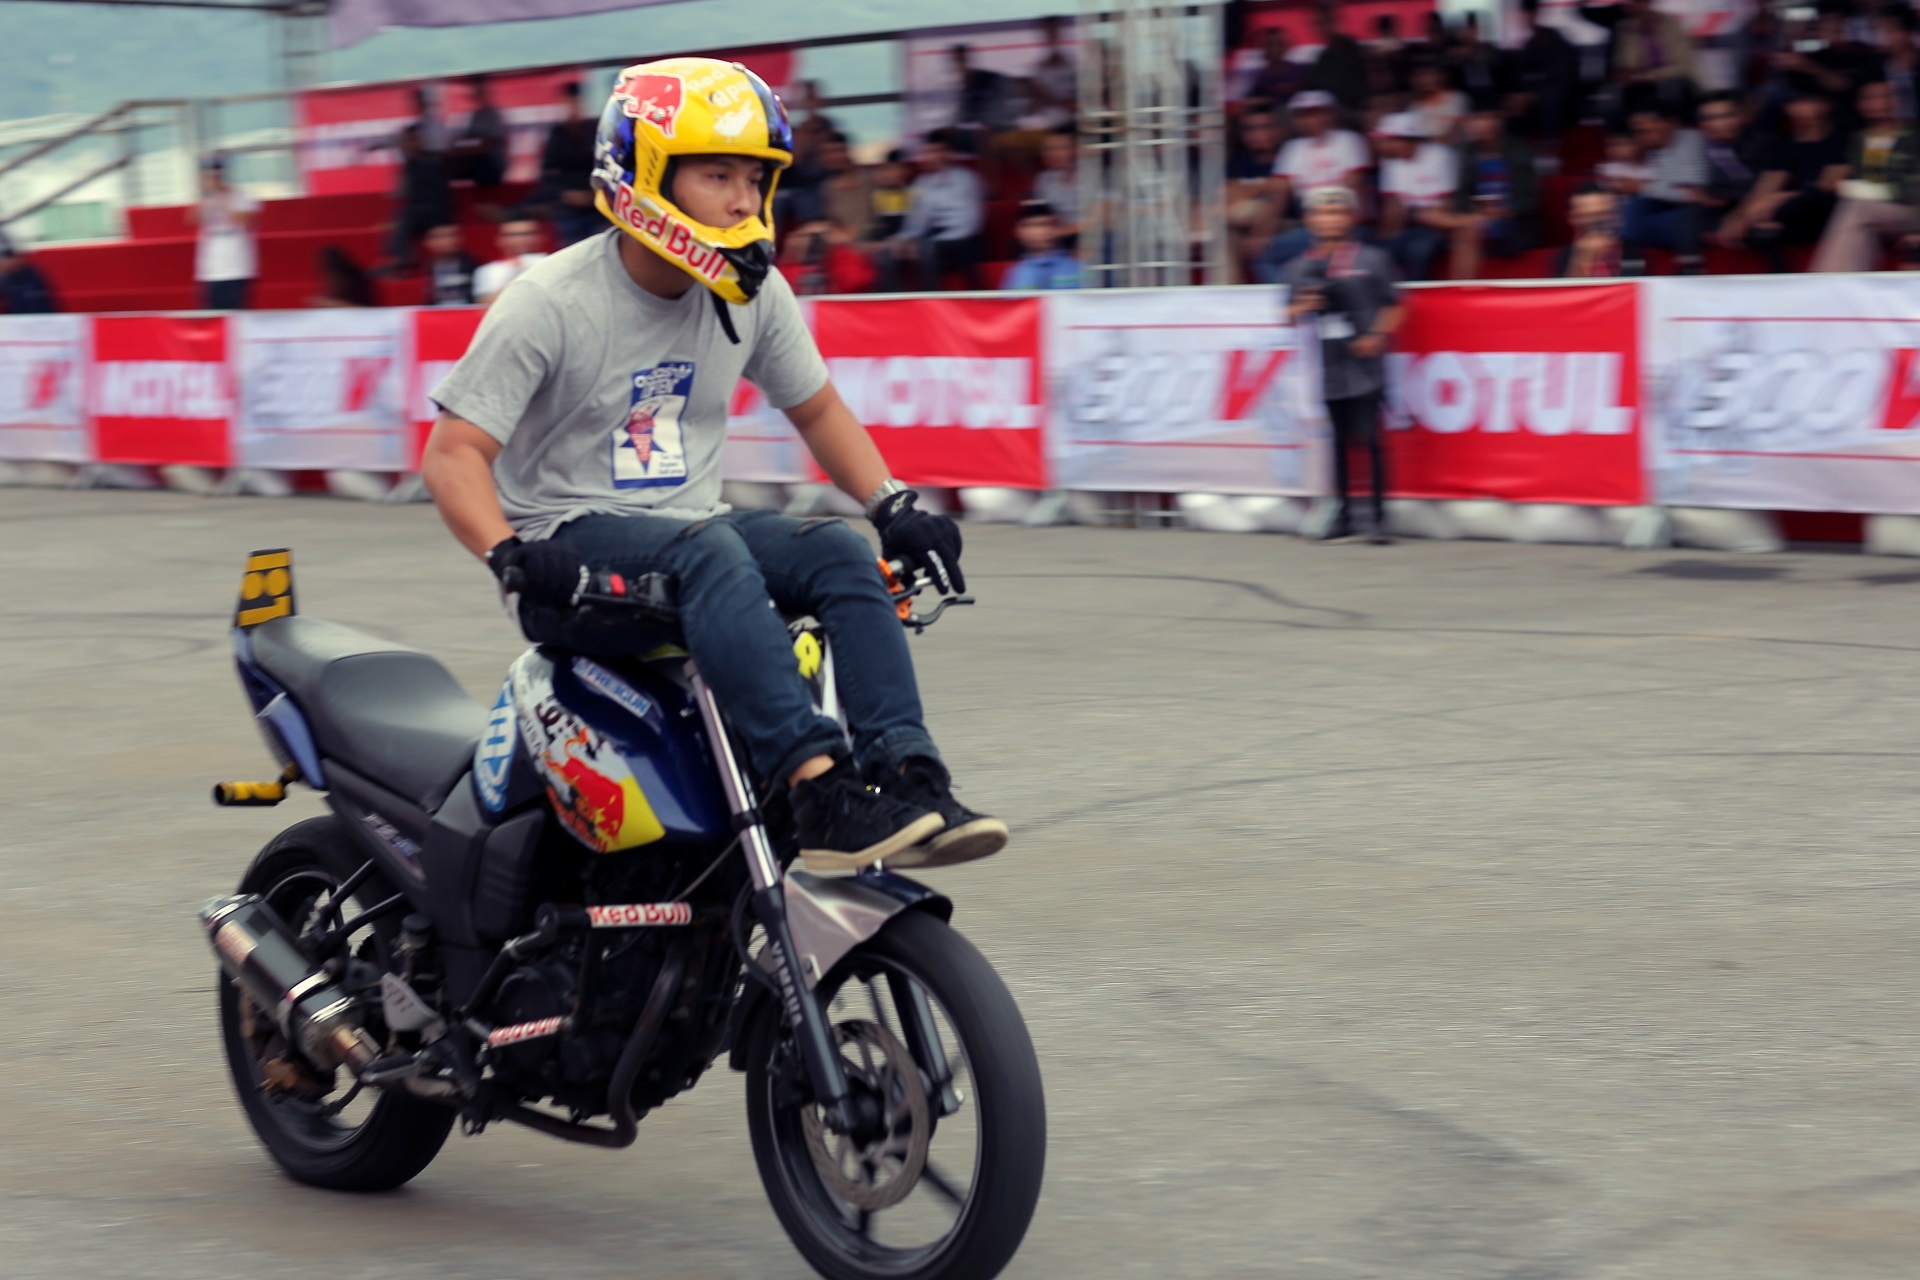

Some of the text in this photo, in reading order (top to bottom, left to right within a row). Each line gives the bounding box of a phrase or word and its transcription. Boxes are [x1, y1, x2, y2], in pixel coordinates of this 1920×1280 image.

[614, 184, 727, 280] Red Bull
[644, 902, 690, 924] Bull
[769, 940, 803, 1028] YAMAHA
